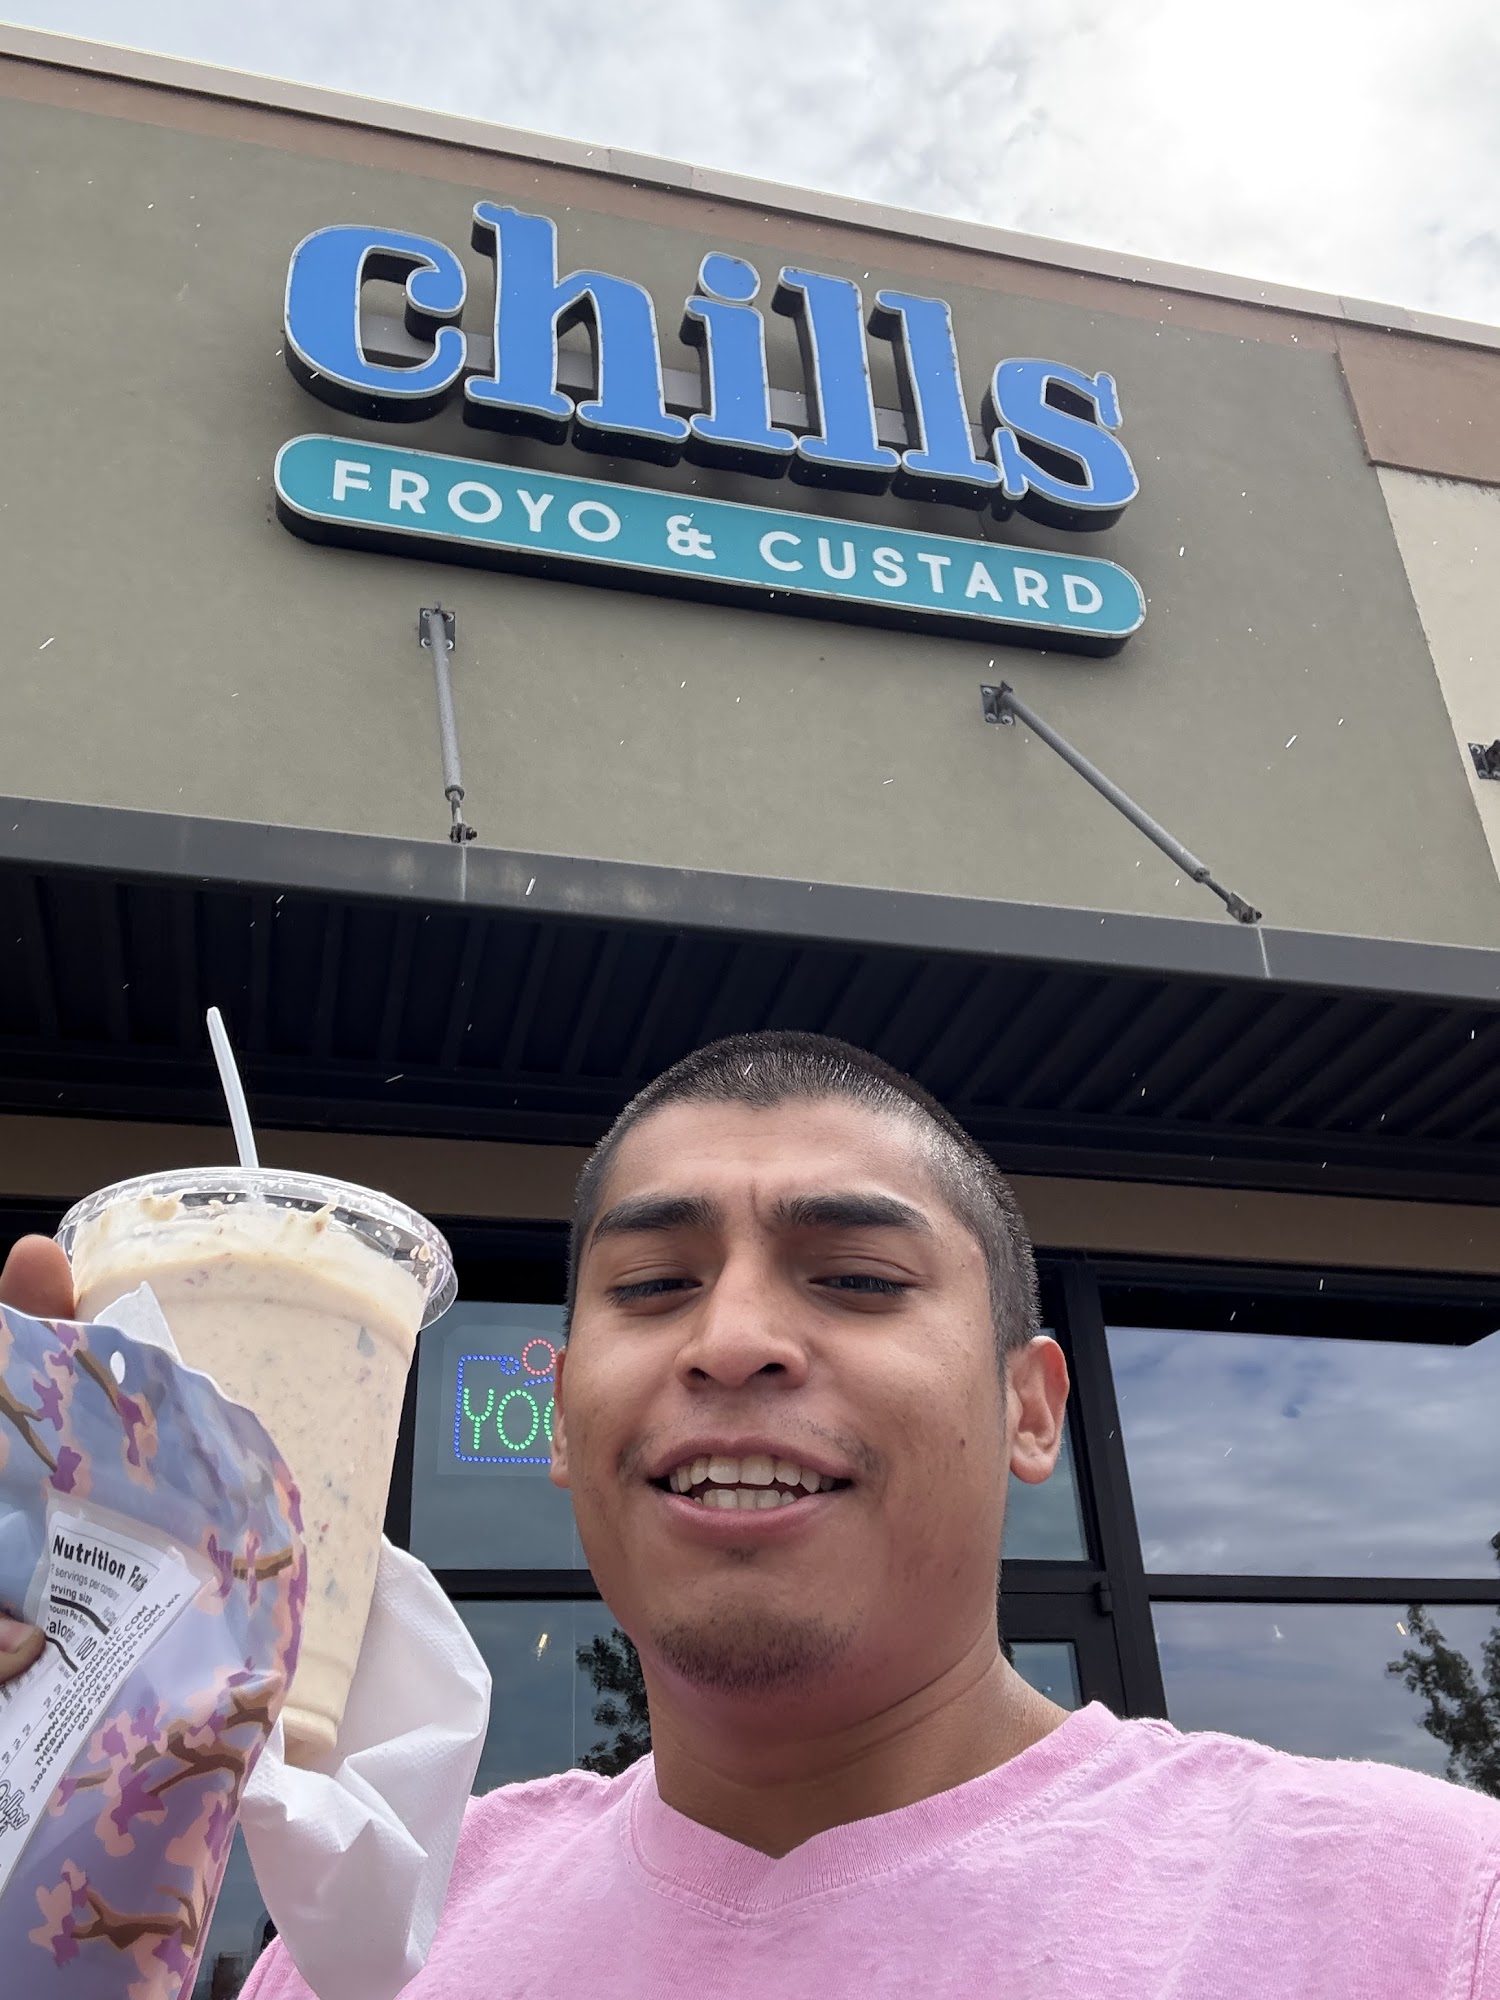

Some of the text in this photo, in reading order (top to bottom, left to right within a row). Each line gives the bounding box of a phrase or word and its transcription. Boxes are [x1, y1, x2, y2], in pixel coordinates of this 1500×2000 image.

[283, 202, 1140, 510] chills
[332, 458, 1103, 615] FROYO & CUSTARD
[52, 1534, 126, 1580] Nutrition
[51, 1583, 77, 1601] erving
[48, 1689, 72, 1720] BOSS
